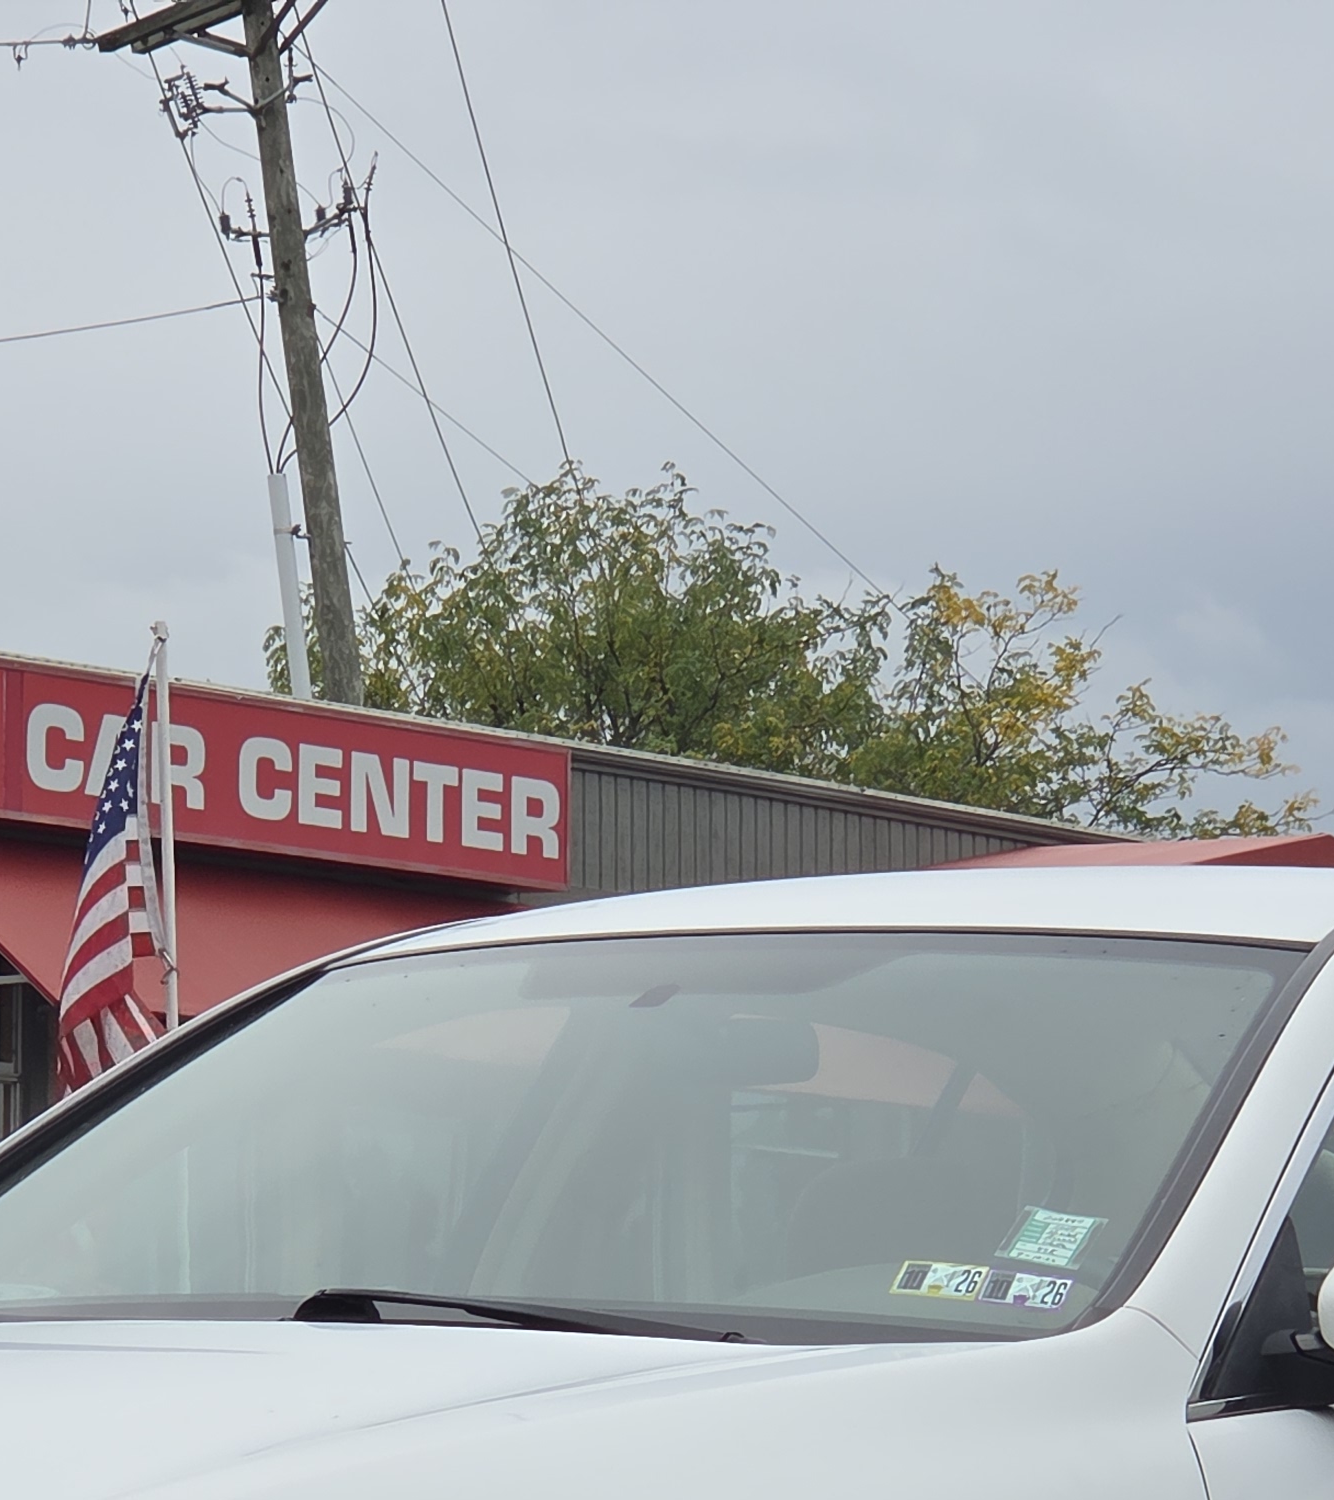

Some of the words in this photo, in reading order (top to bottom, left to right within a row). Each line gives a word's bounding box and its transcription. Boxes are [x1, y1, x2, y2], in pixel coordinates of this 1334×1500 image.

[238, 736, 561, 859] CENTER
[953, 1269, 982, 1294] 26
[1040, 1280, 1068, 1306] 26
